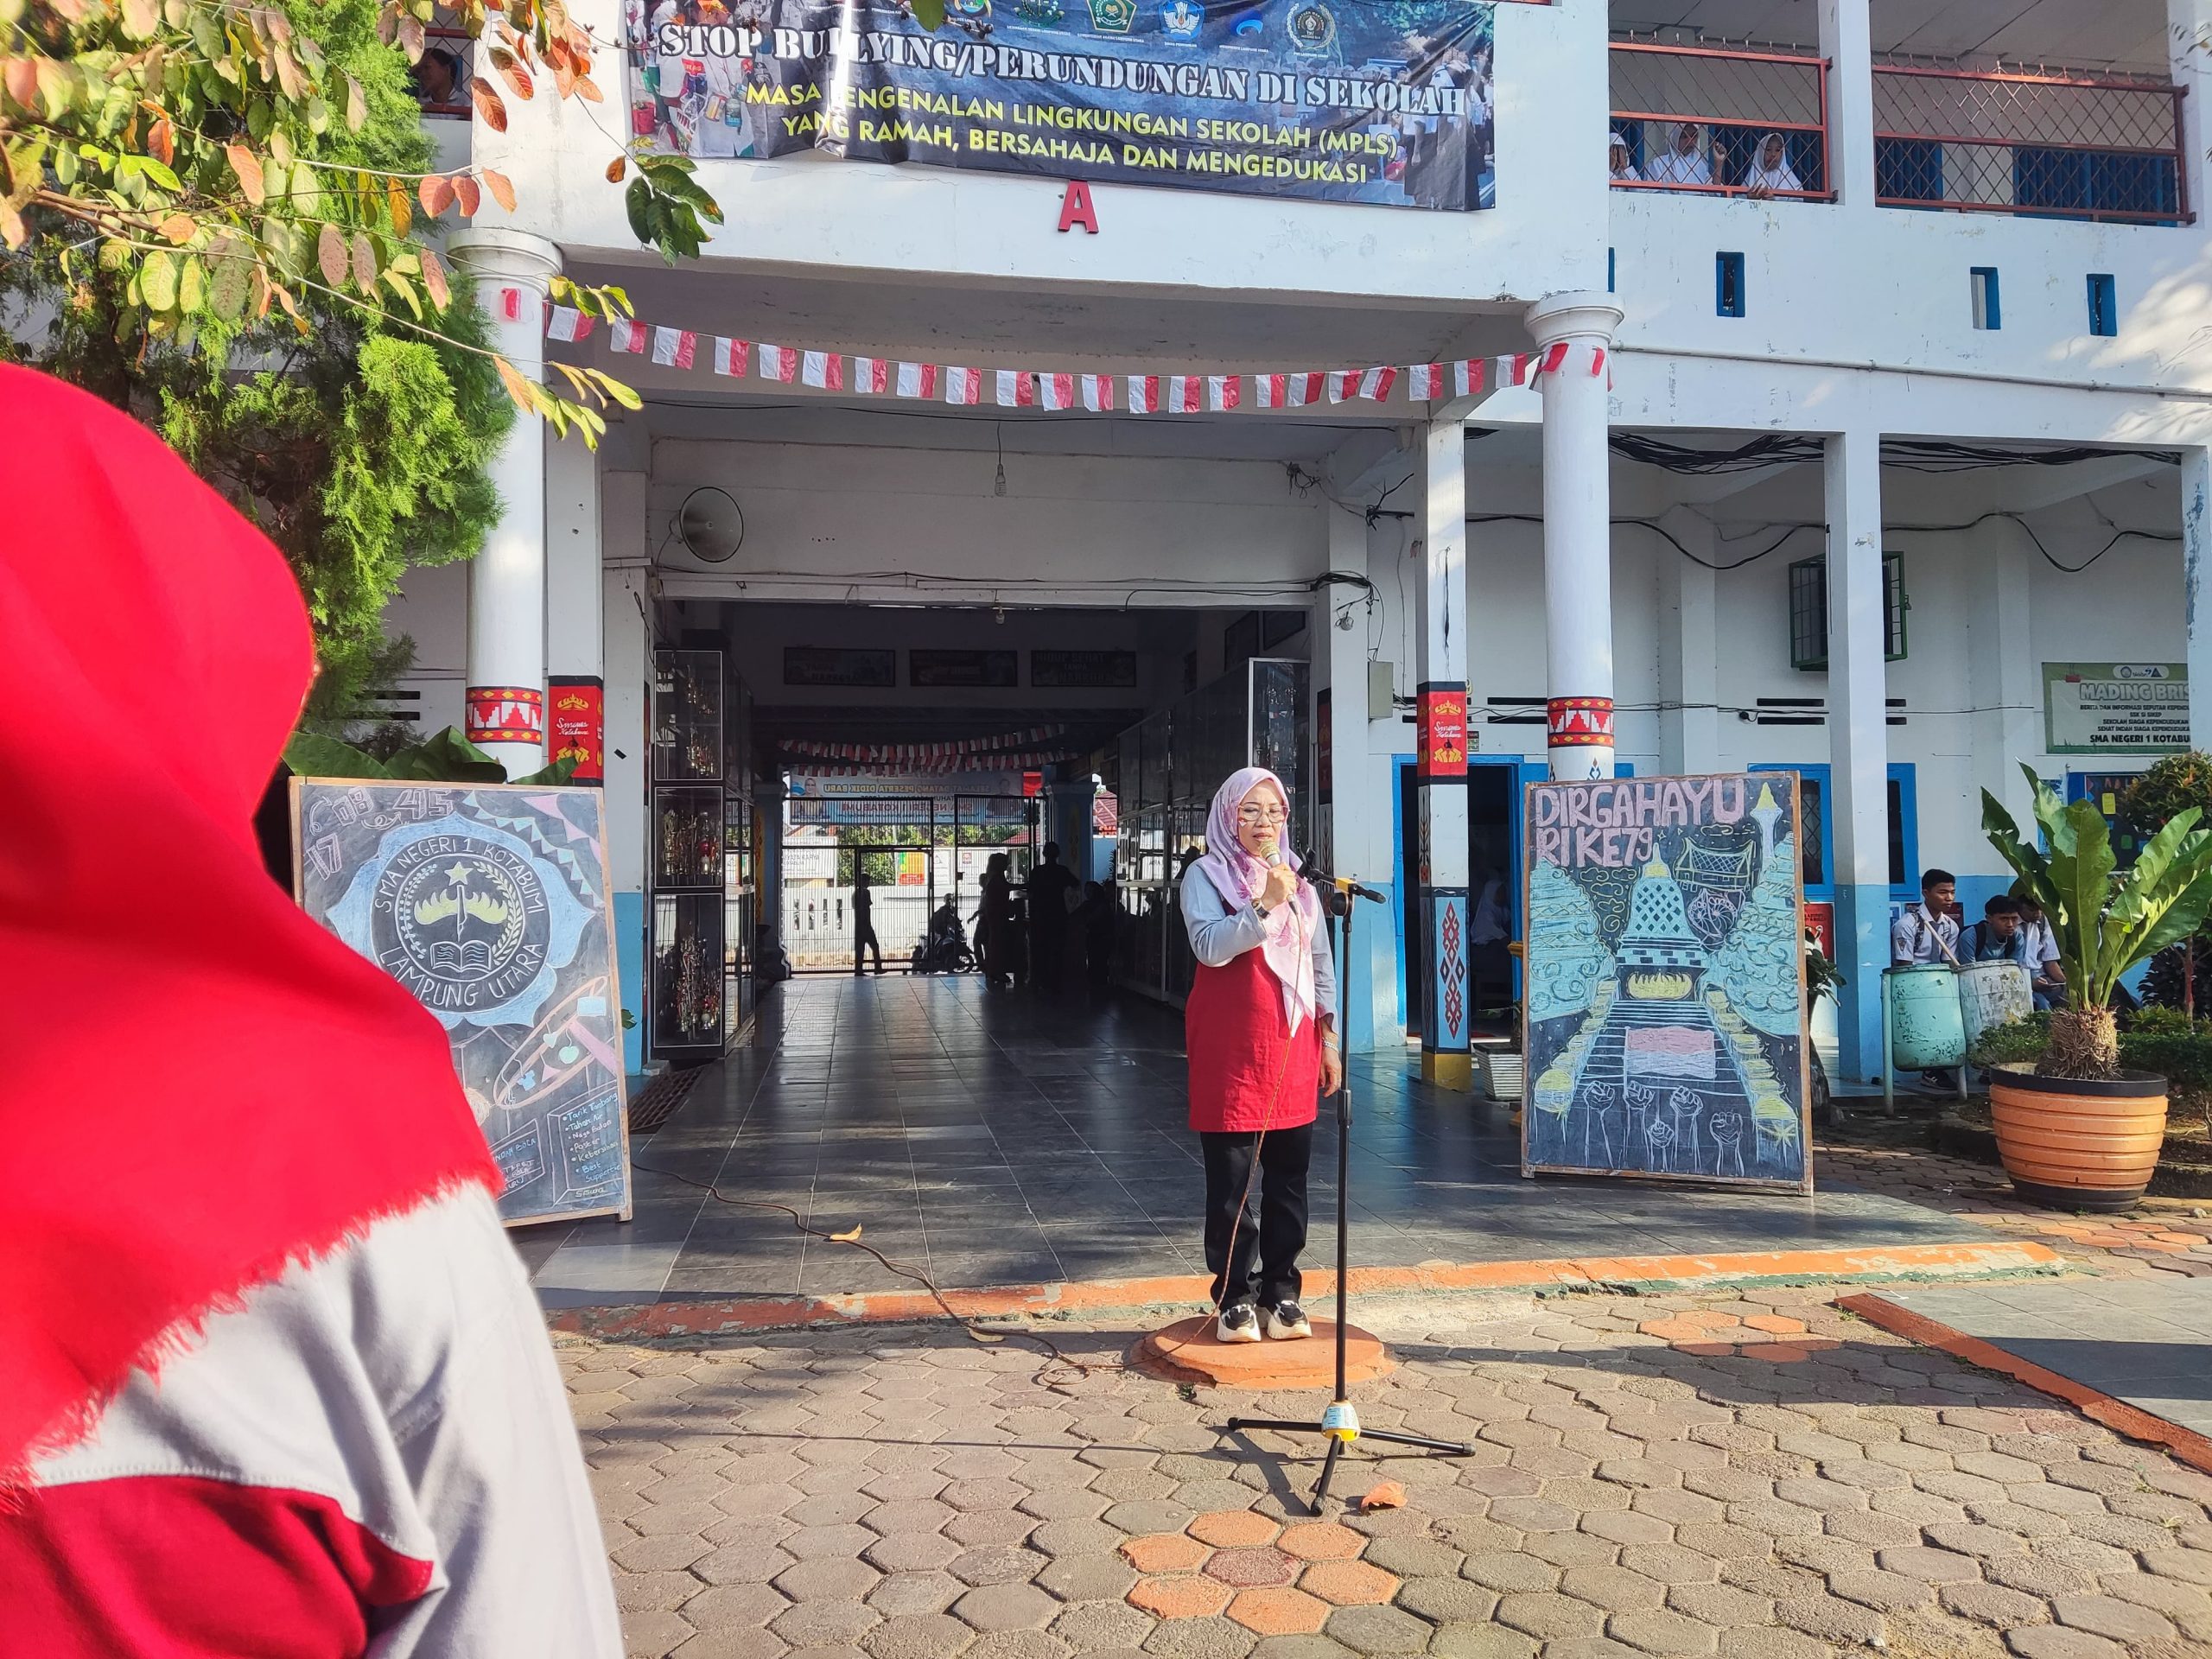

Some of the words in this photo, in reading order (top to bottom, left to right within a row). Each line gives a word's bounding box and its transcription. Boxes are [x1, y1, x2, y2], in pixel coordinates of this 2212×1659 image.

[660, 24, 762, 58] STOP
[1257, 71, 1298, 105] DI
[1306, 75, 1467, 117] SEKOLAH
[746, 81, 822, 106] MASA
[1013, 103, 1188, 138] LINGKUNGAN
[1196, 118, 1311, 149] SEKOLAH
[1319, 128, 1398, 159] (MPLS)
[780, 111, 849, 139] YANG
[859, 119, 959, 152] RAMAH,
[969, 128, 1116, 165] BERSAHAJA
[1123, 144, 1178, 169] DAN
[1186, 150, 1367, 184] MENGEDUKASI
[1058, 180, 1099, 234] A
[2080, 683, 2152, 701] MADING
[2090, 734, 2109, 743] SMA
[2111, 734, 2144, 743] NEGERI
[2145, 734, 2151, 743] 1
[2152, 734, 2191, 743] KOTABU
[393, 788, 454, 820] 45
[1535, 777, 1745, 828] DIRGAHAYU
[305, 832, 342, 881] 17
[1535, 827, 1570, 867] RI
[374, 869, 404, 913] SMA
[397, 836, 457, 868] NEGERI
[484, 843, 546, 914] KOTABUMI
[379, 946, 480, 1008] LAMPUNG
[487, 944, 544, 999] UTARA
[566, 1106, 588, 1122] Tarik
[582, 1160, 601, 1174] Best
